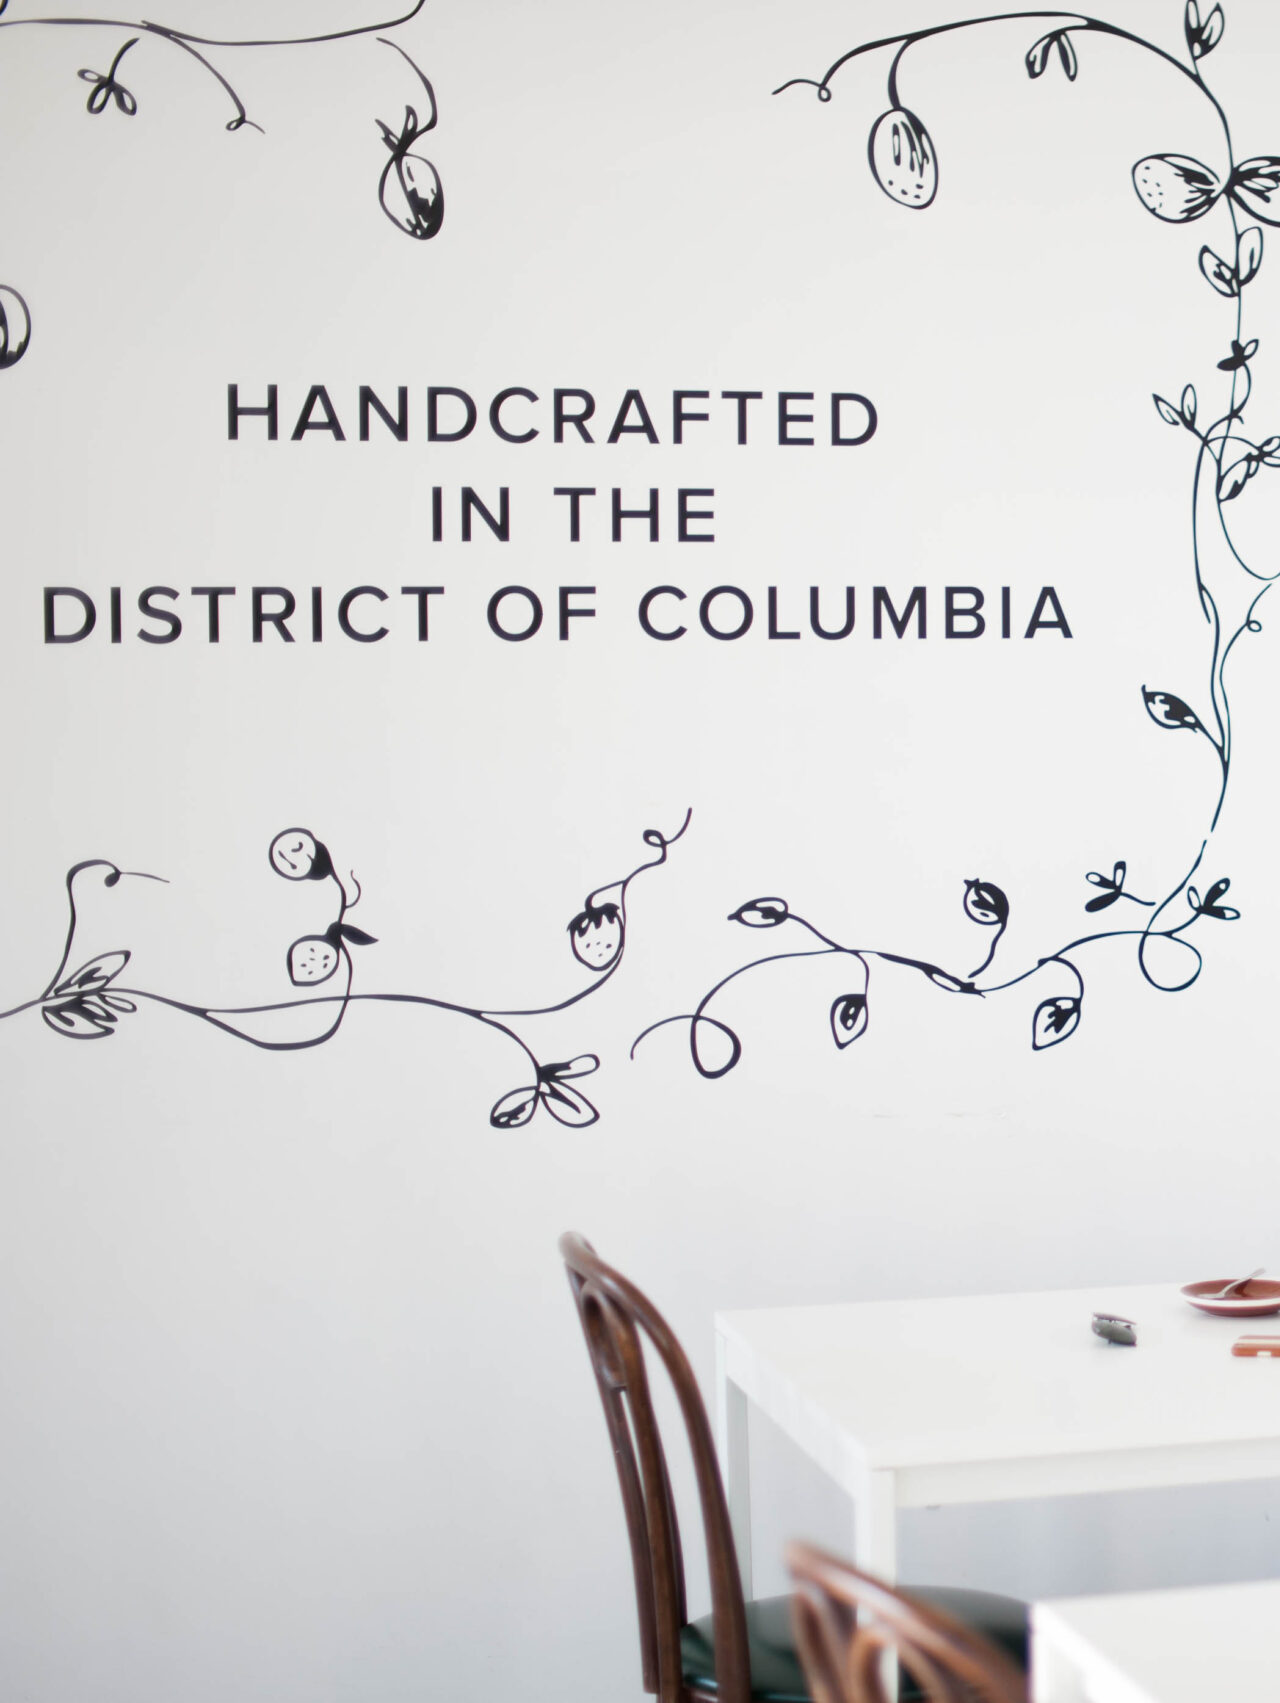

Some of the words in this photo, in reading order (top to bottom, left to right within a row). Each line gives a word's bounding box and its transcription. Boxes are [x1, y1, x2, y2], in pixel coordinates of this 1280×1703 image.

[227, 384, 878, 447] HANDCRAFTED
[432, 486, 510, 542] IN
[553, 487, 715, 543] THE
[43, 586, 445, 645] DISTRICT
[486, 585, 596, 642] OF
[638, 585, 1073, 641] COLUMBIA
